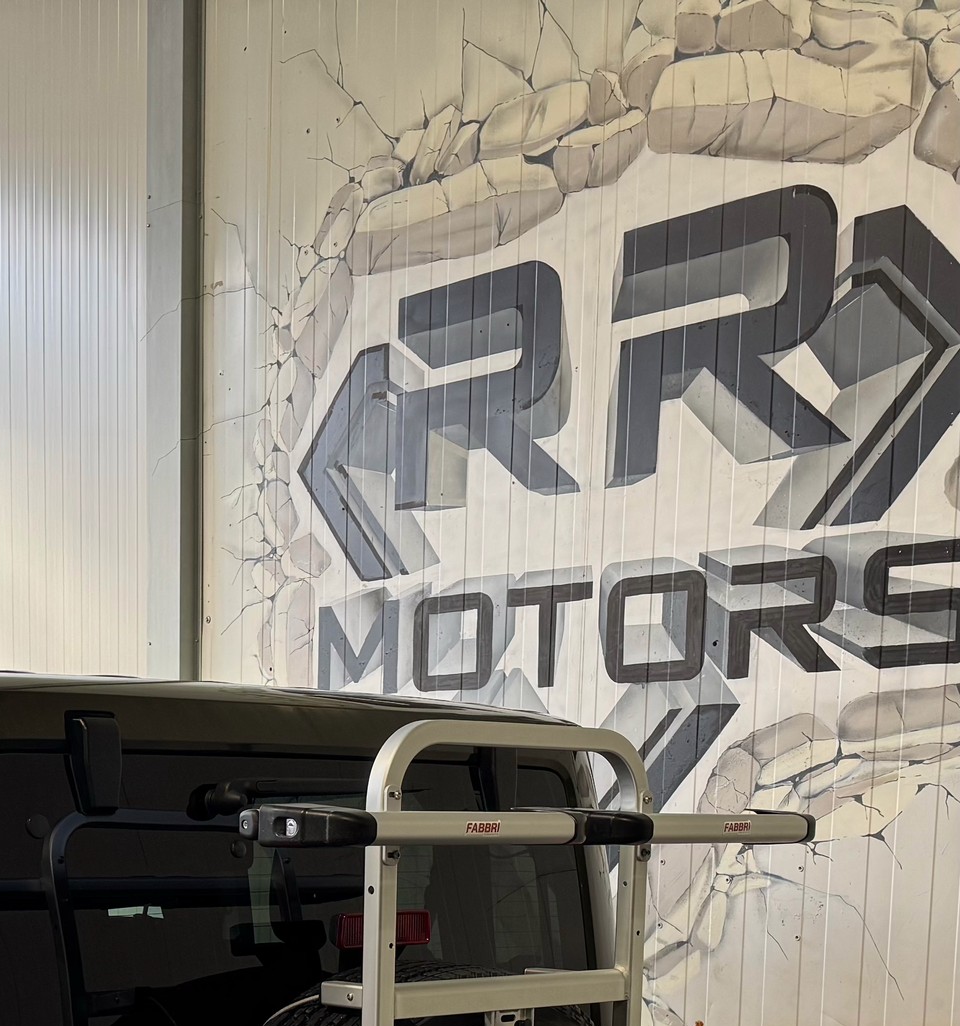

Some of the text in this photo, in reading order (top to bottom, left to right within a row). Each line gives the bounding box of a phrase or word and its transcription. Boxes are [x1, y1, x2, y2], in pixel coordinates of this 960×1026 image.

[394, 183, 851, 511] RR
[317, 536, 960, 693] MOTORS
[466, 822, 500, 834] FABBRI
[723, 821, 751, 833] FABBRI
